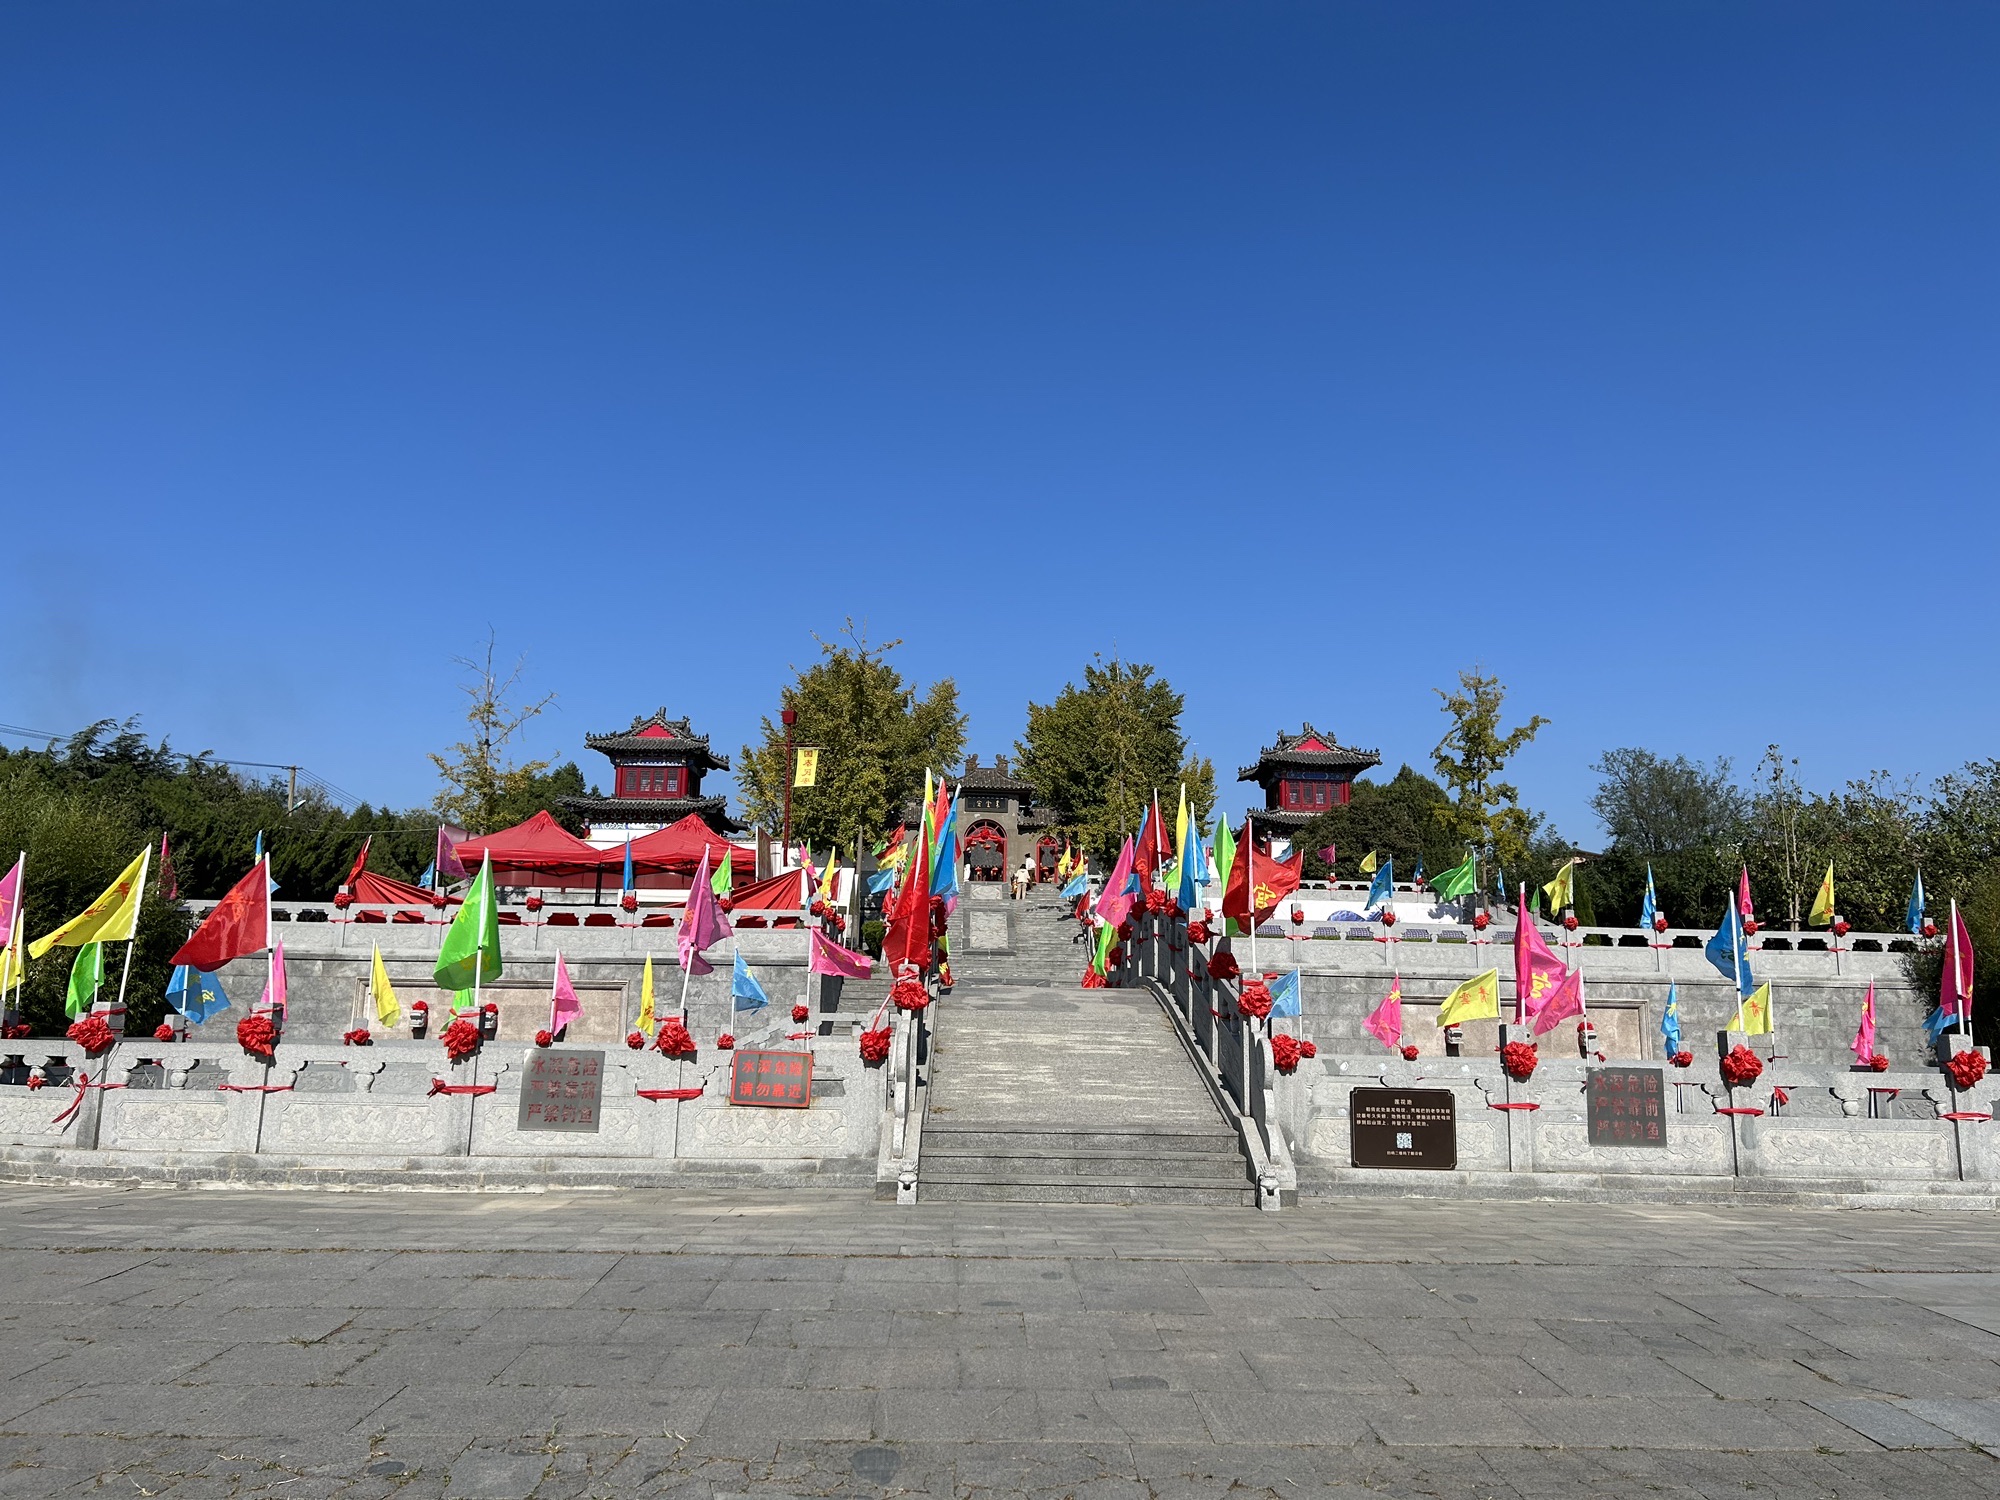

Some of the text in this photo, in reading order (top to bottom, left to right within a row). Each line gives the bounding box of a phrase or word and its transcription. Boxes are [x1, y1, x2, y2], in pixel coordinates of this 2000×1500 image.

[531, 1056, 599, 1076] 水深危险
[741, 1059, 804, 1077] 水深危险
[528, 1080, 597, 1099] 严禁靠前
[739, 1081, 802, 1099] 请勿靠近
[1594, 1074, 1658, 1093] 水深危险
[526, 1103, 593, 1124] 严禁钓鱼
[1595, 1096, 1659, 1117] 严禁靠前
[1596, 1120, 1661, 1140] 严禁钓鱼
